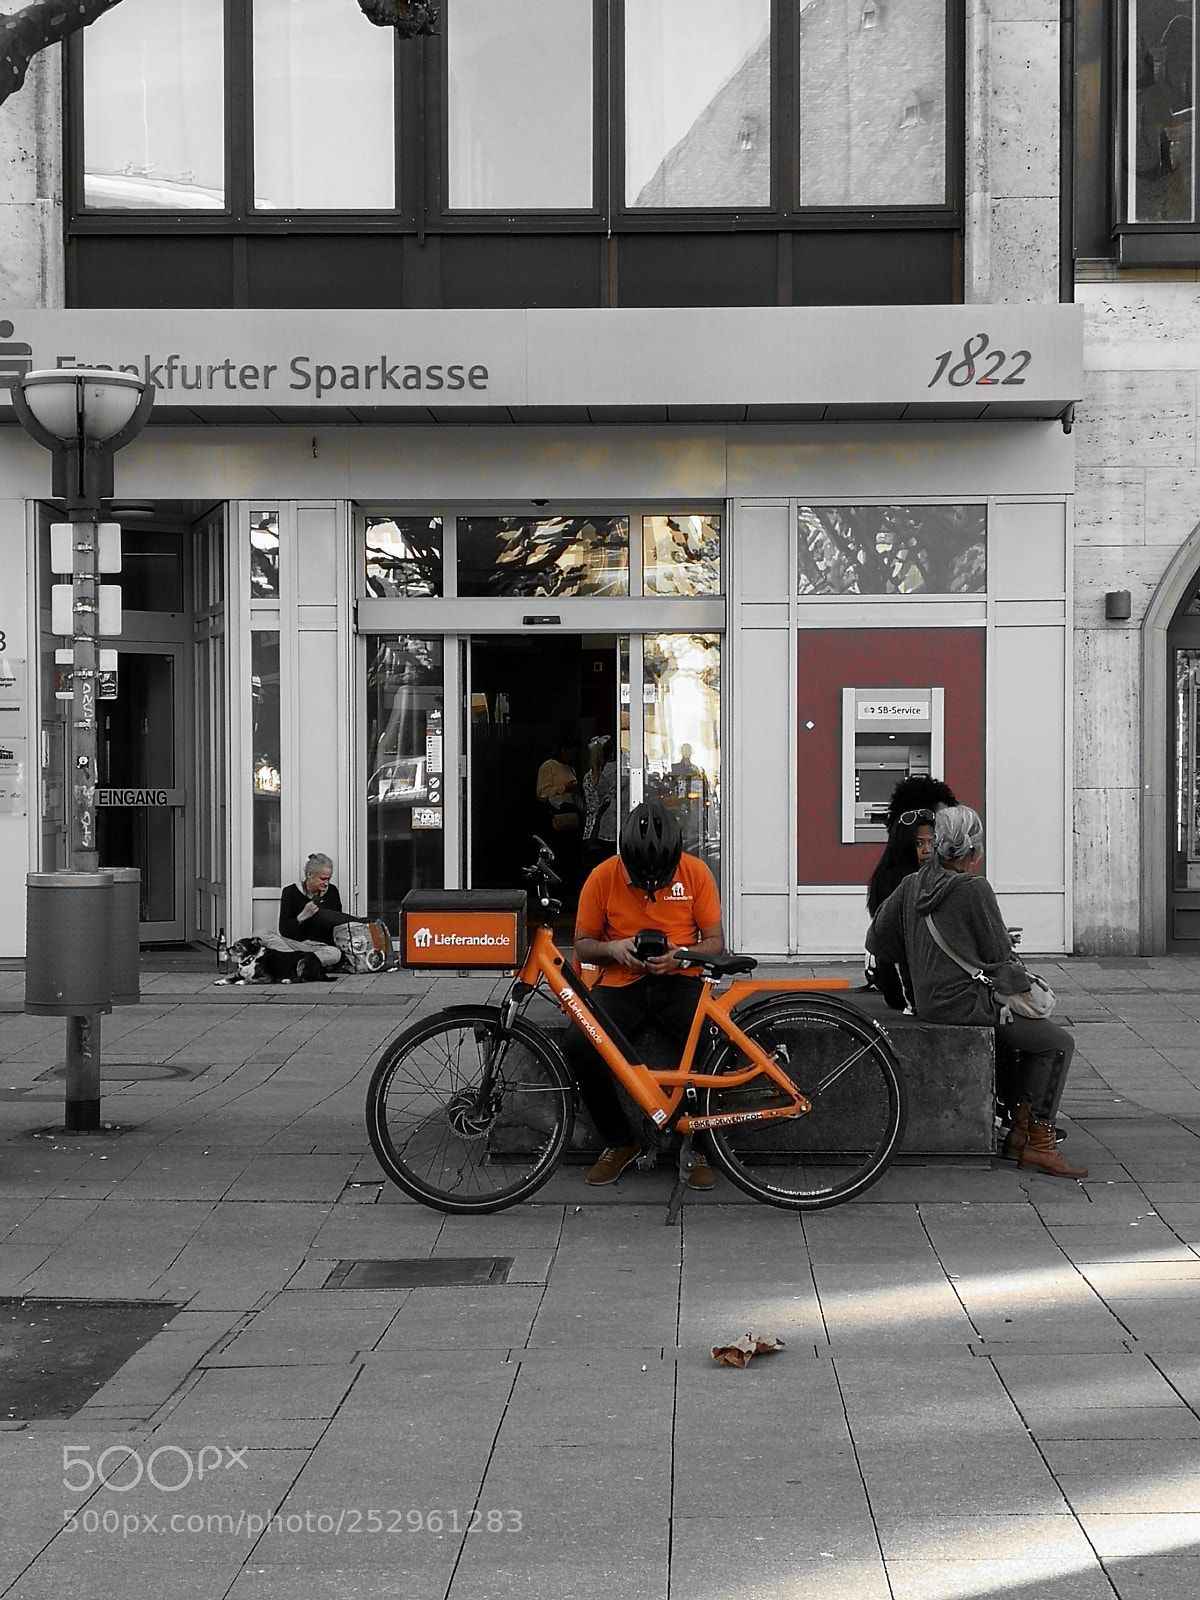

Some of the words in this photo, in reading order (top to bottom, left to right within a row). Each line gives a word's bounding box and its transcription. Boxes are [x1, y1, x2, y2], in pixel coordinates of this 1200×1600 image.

[927, 332, 1032, 388] 1822
[289, 354, 489, 399] Sparkasse
[877, 705, 922, 715] SB-Service
[98, 789, 168, 805] EINGANG
[434, 933, 510, 946] Lieferando.de
